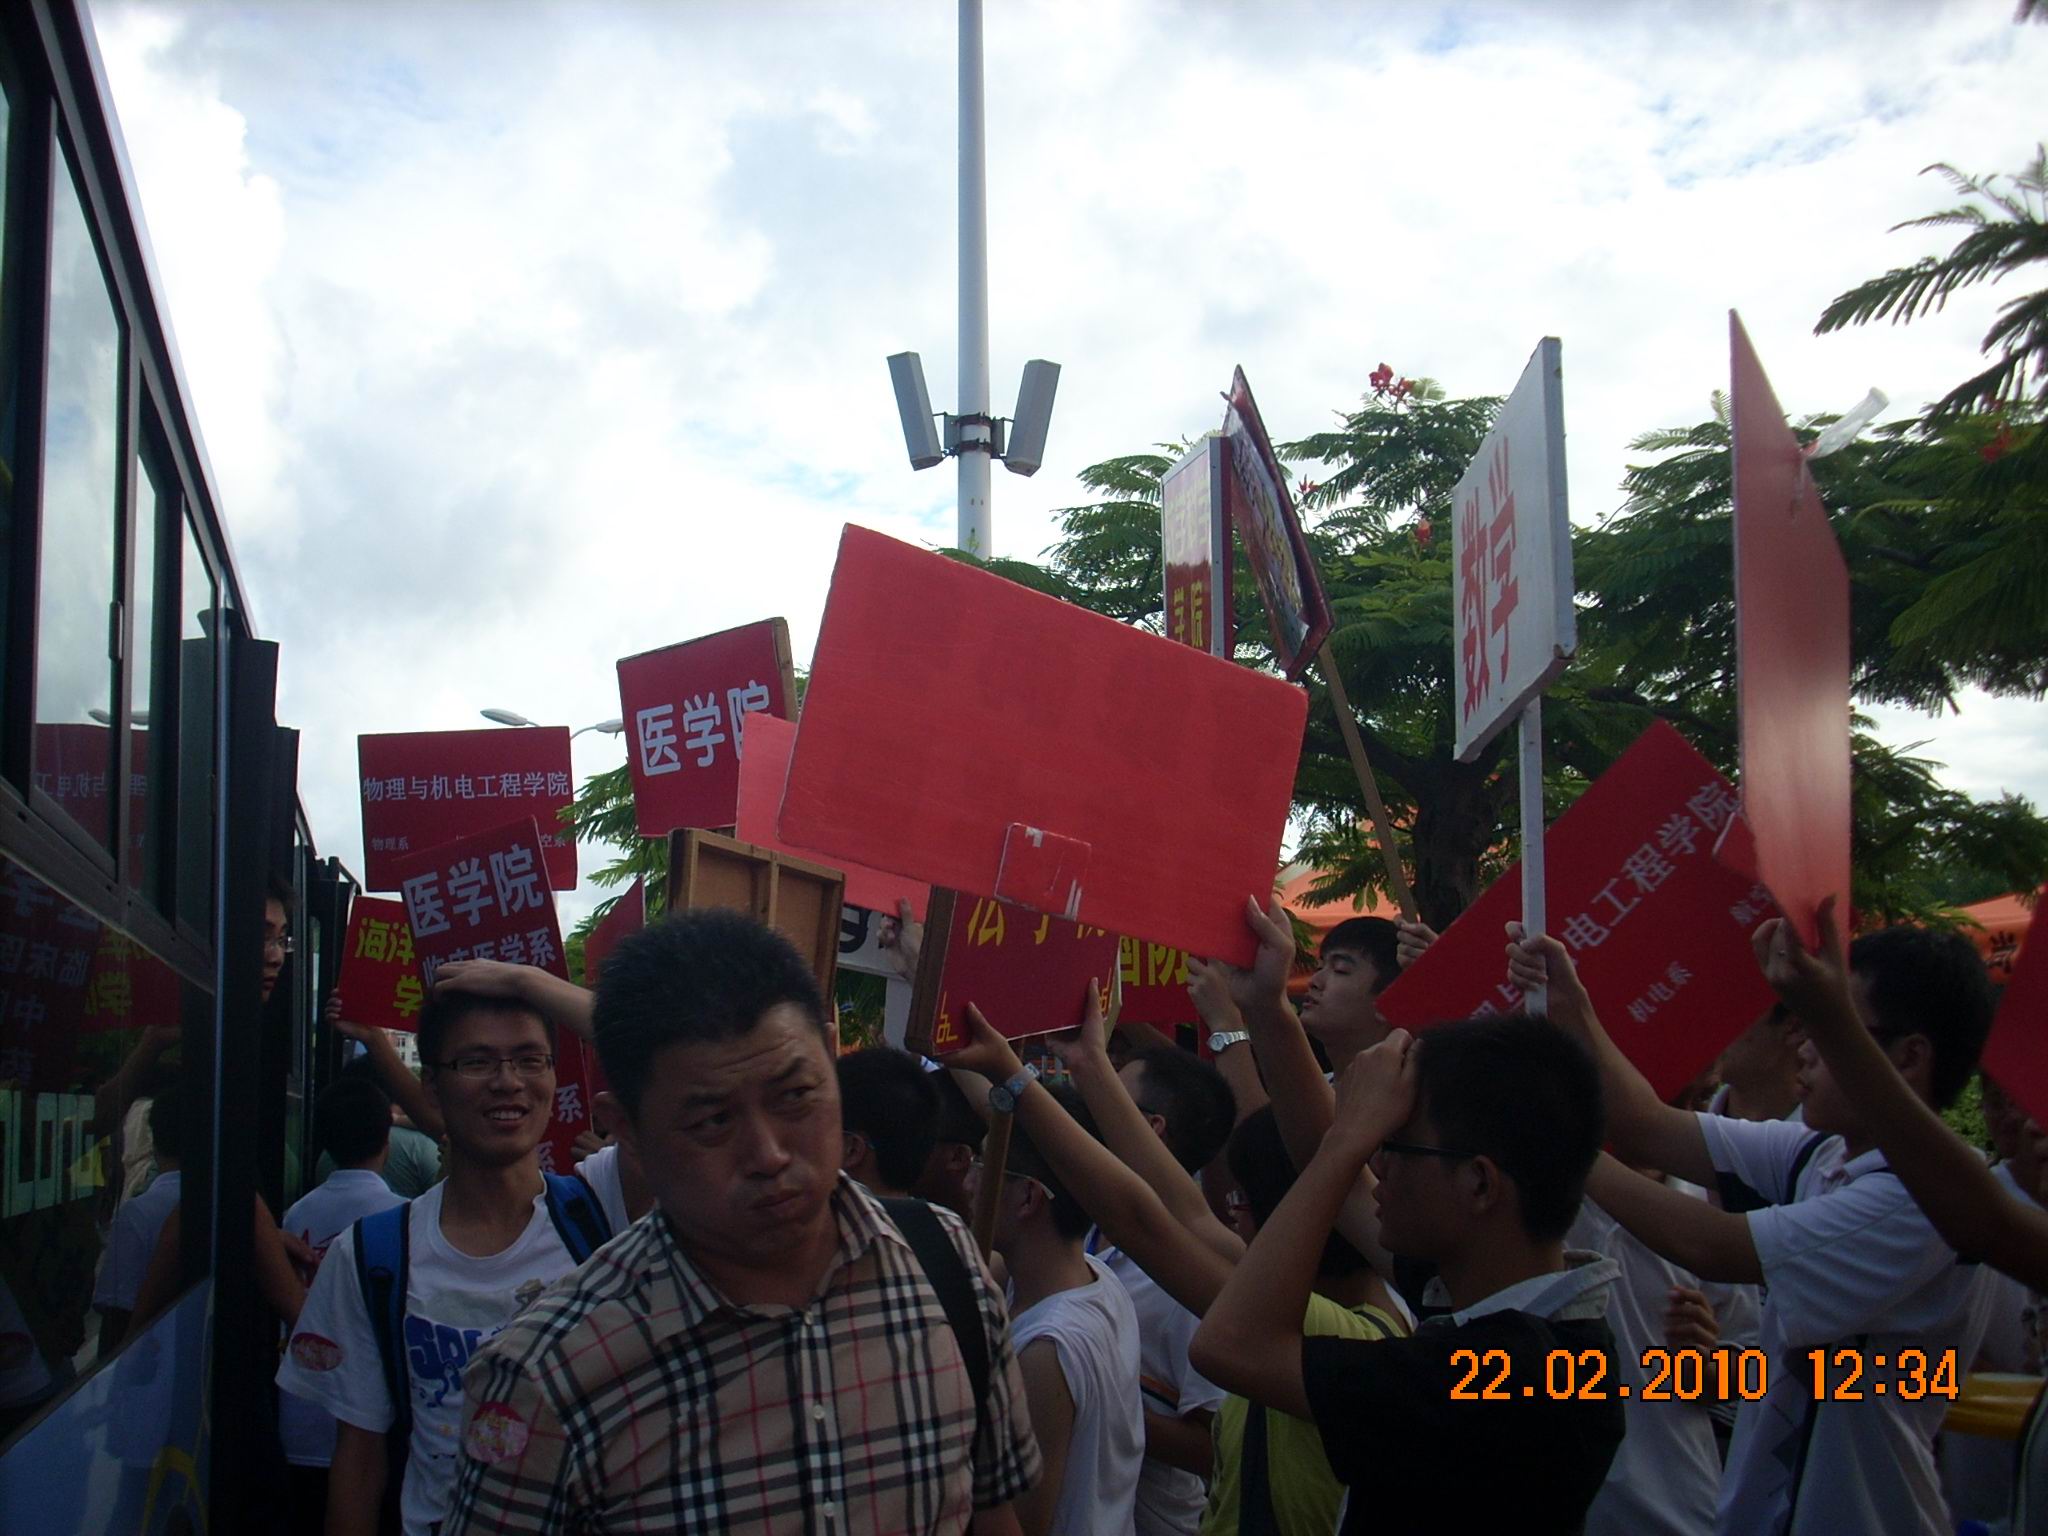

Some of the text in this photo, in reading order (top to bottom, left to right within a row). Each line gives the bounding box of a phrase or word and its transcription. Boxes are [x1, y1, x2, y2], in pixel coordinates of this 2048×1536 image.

[1460, 435, 1520, 725] 数学
[363, 771, 571, 802] 物理与机电工程学院
[371, 835, 409, 852] 物理系
[402, 843, 545, 939] 医学院
[1626, 960, 1695, 1023] 机电系
[556, 1082, 584, 1124] 系
